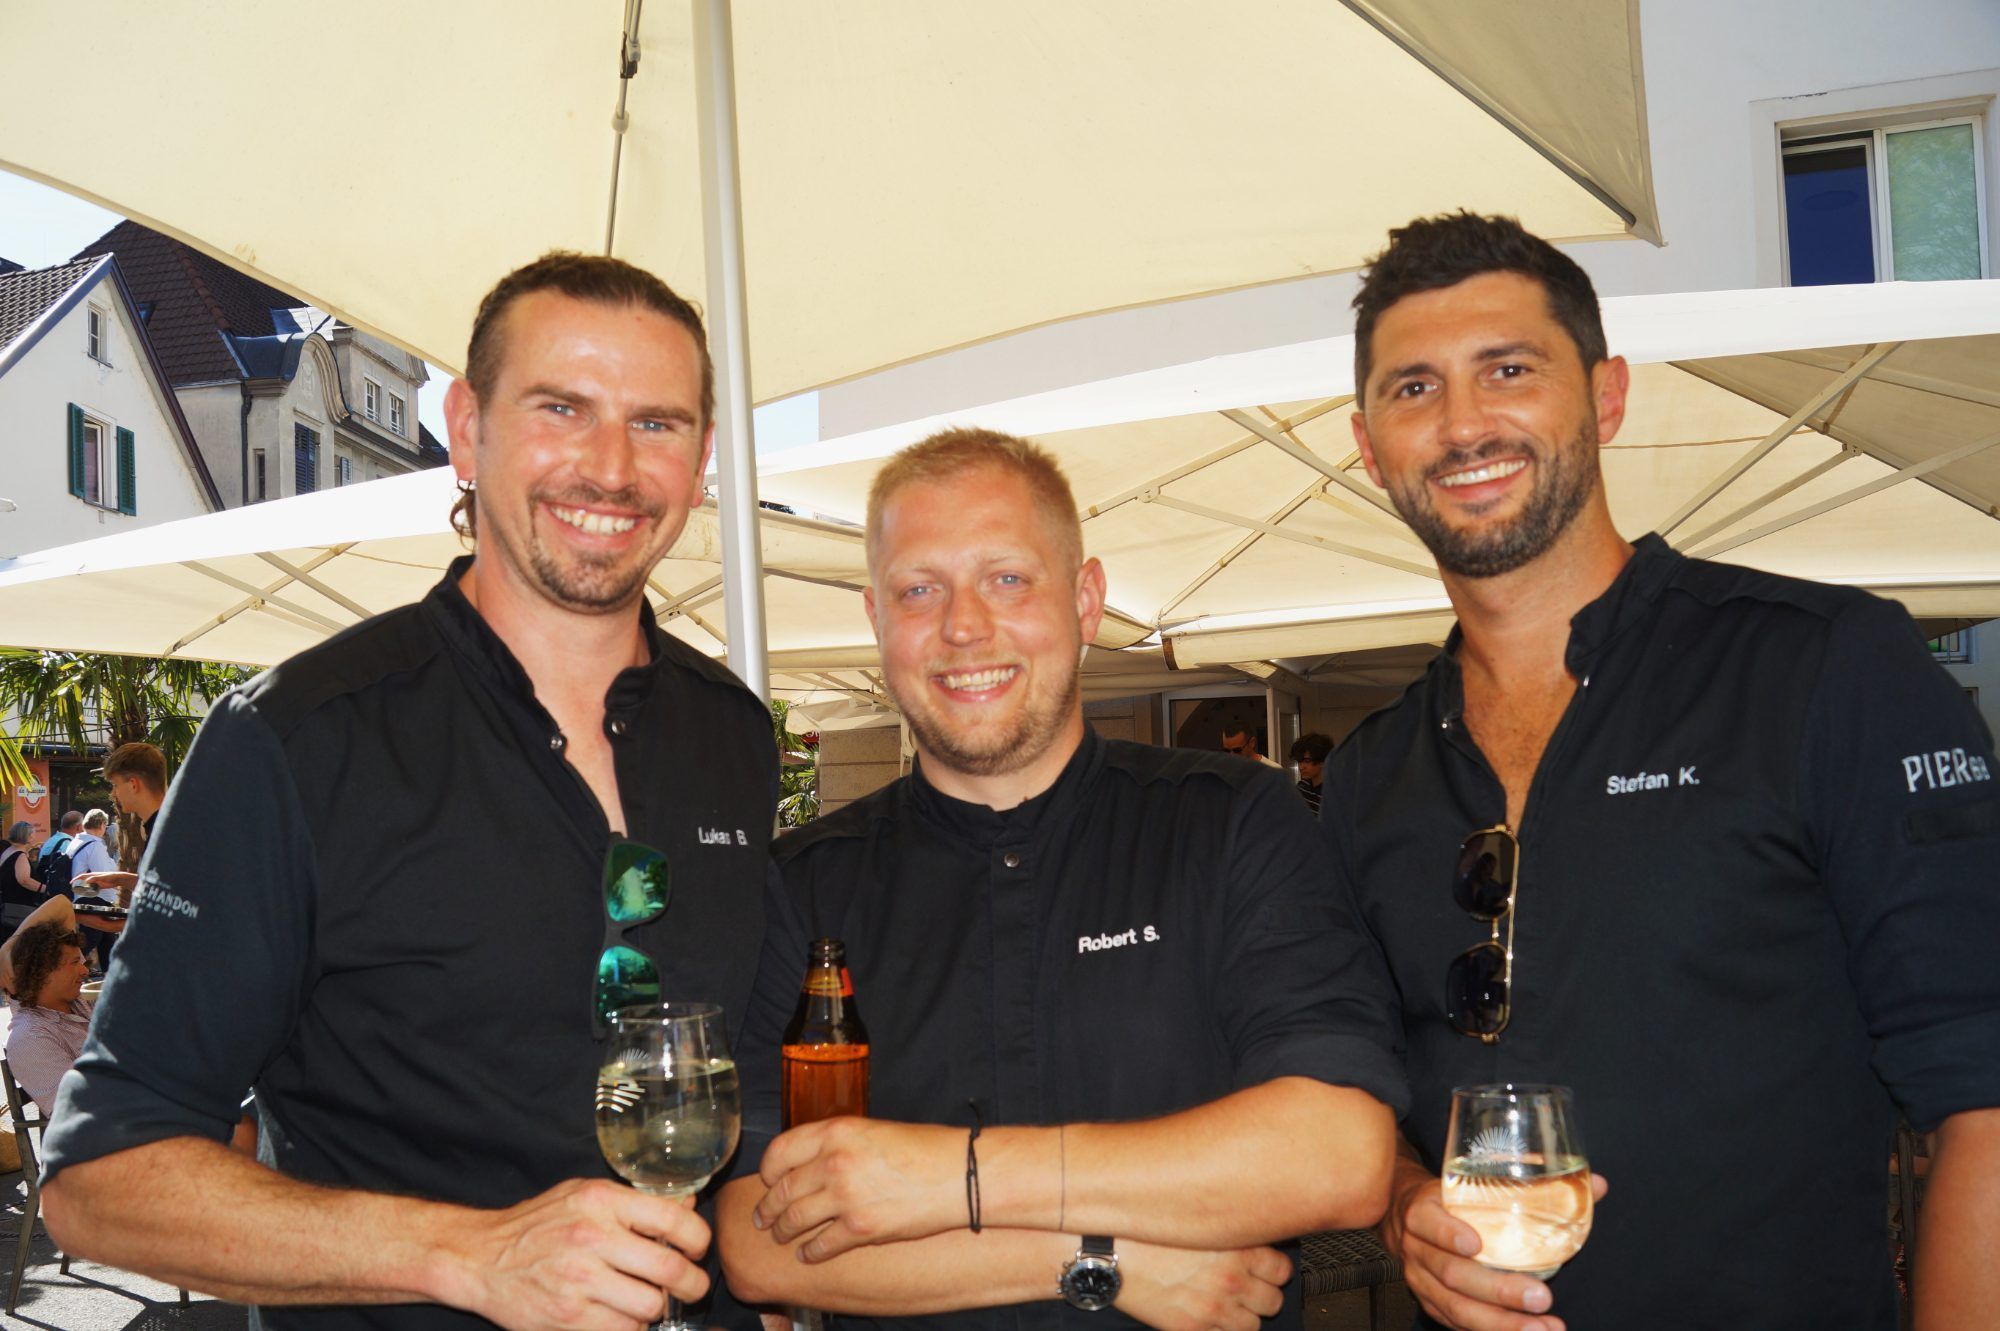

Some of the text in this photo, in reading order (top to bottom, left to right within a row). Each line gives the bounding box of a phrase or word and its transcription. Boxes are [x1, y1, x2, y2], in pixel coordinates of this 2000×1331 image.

[1606, 766, 1700, 795] Stefan K.
[698, 827, 731, 845] Lukas
[1079, 925, 1160, 953] Robert S.
